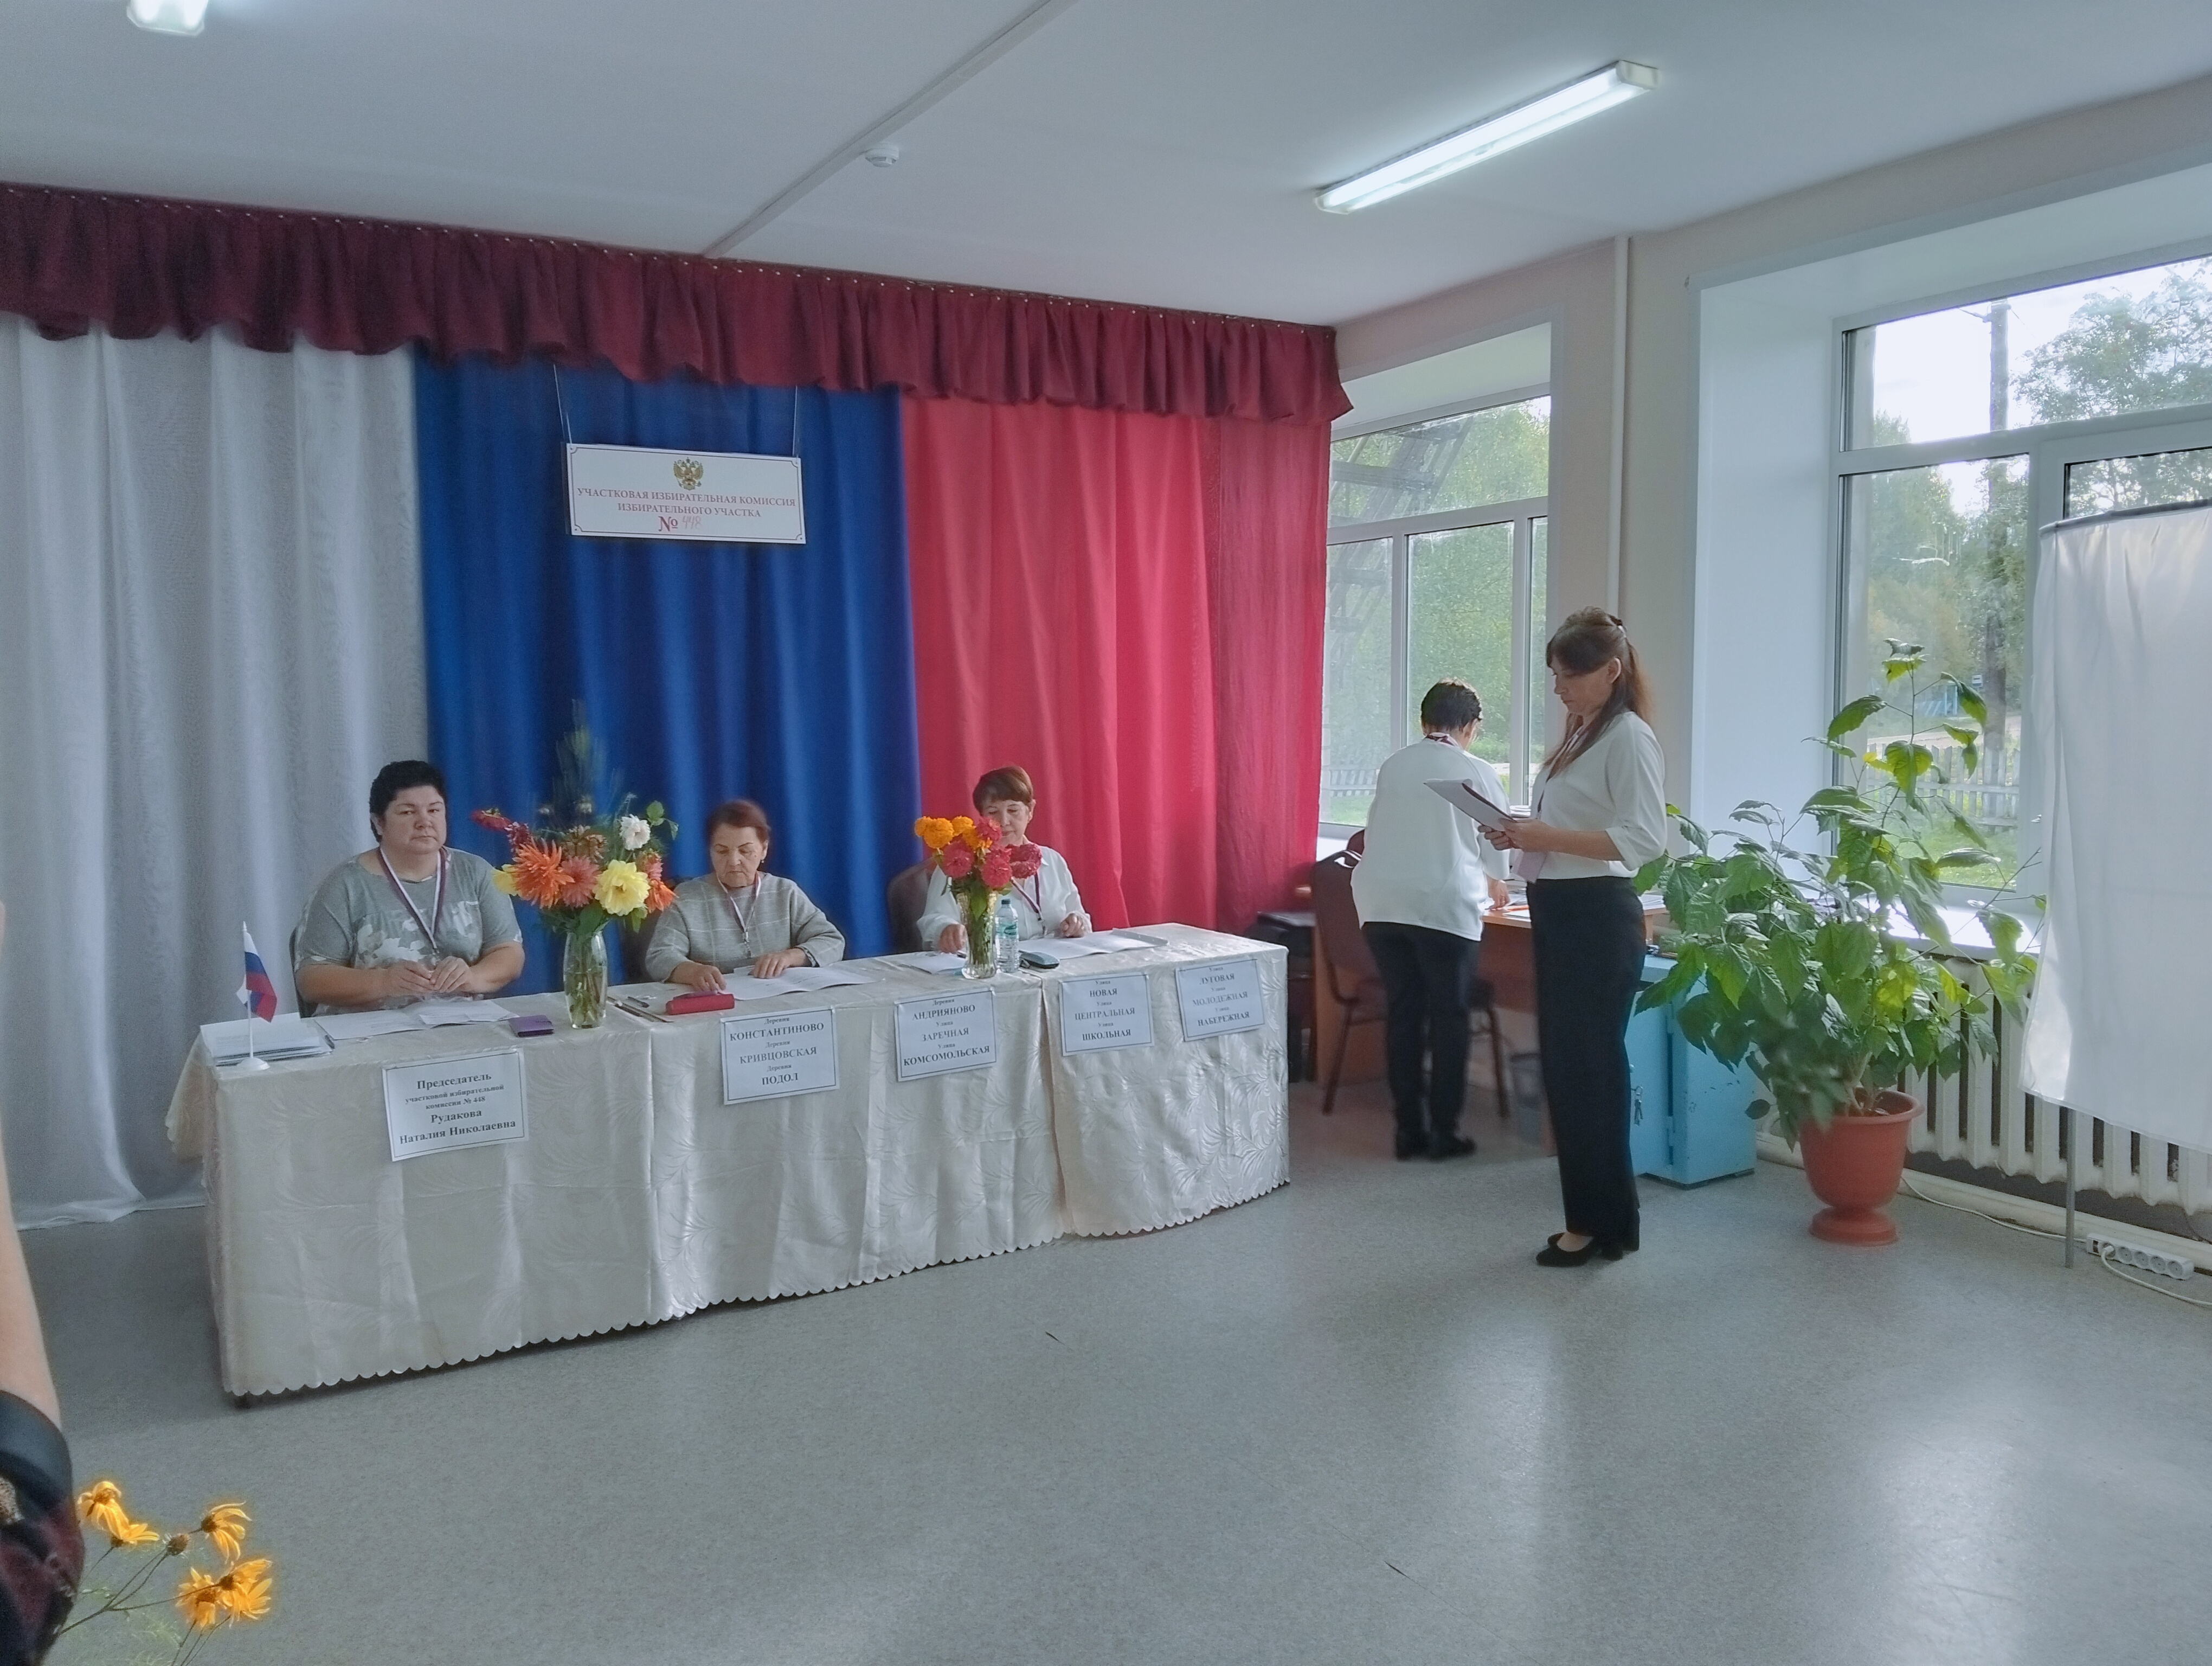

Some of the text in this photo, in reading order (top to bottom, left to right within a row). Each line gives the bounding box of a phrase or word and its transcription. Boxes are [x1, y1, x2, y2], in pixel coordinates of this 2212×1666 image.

[577, 488, 796, 507] УЧАСТКОВАЯ ИЗБИРАТЕЛЬНАЯ КОМИССИЯ
[618, 503, 762, 517] ИЗБИРАТЕЛЬНОГО УЧАСТКА
[658, 516, 678, 532] №
[1089, 988, 1117, 998] НОВАЯ
[912, 1004, 975, 1021] АНДРИЯНОВО
[1075, 1007, 1135, 1021] ЦЕНТРАЛЬНАЯ
[1198, 1011, 1250, 1026] НАБЕРЕЖНАЯ
[764, 1017, 790, 1025] Деревня
[730, 1022, 824, 1041] КОНСТАНТИНОВО
[922, 1027, 969, 1042] ЗАРЕЧНАЯ
[1082, 1029, 1131, 1041] ШКОЛЬНАЯ
[740, 1047, 817, 1065] КРИВЦОВСКАЯ
[903, 1046, 990, 1066] КОМСОМОЛЬСКАЯ
[417, 1073, 491, 1090] Председатель
[762, 1073, 799, 1085] ПОДОЛ
[405, 1084, 504, 1104] участковой избирательной
[425, 1100, 461, 1110] комиссии
[430, 1110, 482, 1124] Рудакова
[399, 1120, 516, 1145] Наталия Николаевна
